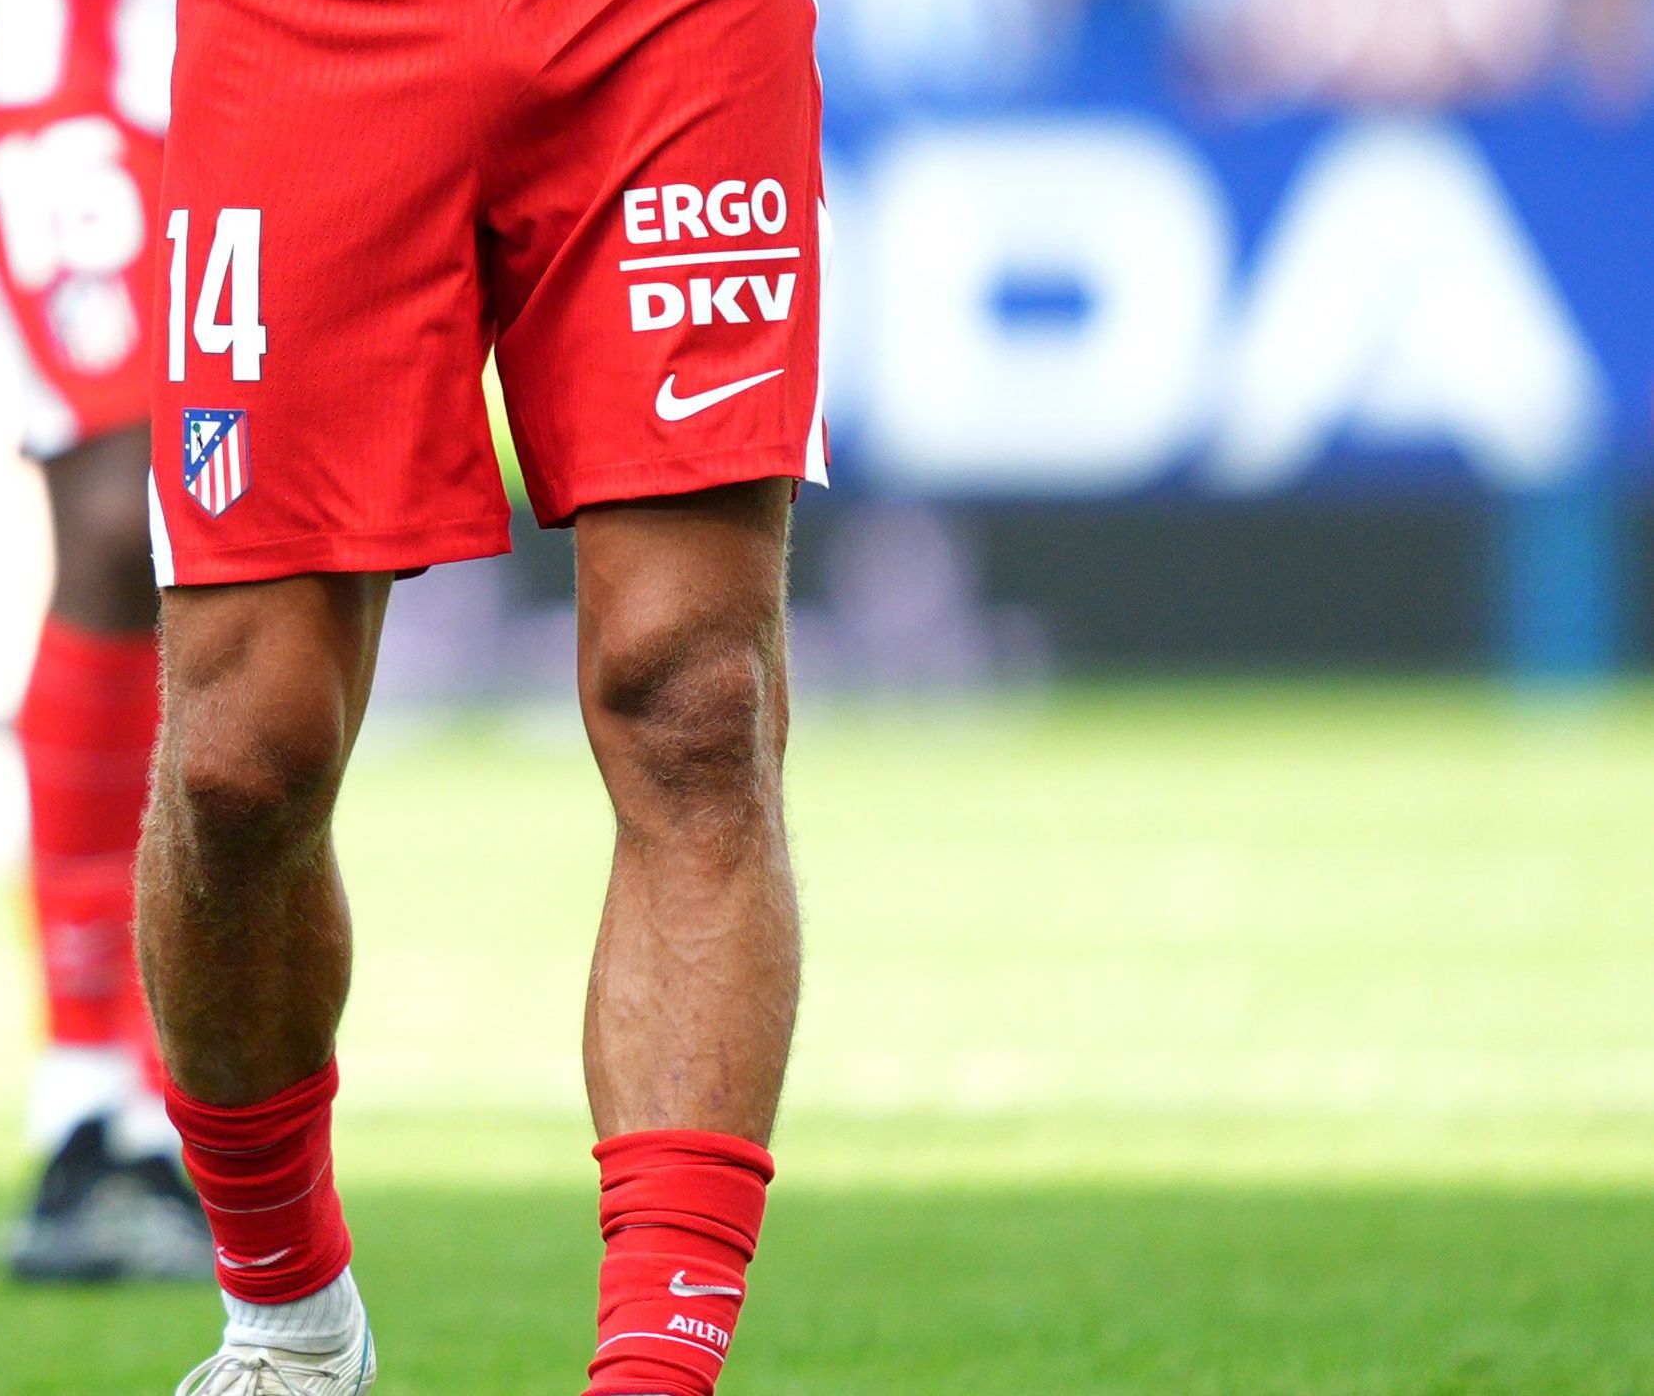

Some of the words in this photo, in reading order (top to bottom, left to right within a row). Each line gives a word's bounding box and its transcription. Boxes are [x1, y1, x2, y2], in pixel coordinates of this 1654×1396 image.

[623, 178, 788, 245] ERGO
[166, 207, 268, 383] 14
[629, 272, 797, 332] DKV
[666, 1314, 729, 1351] ATLETI
